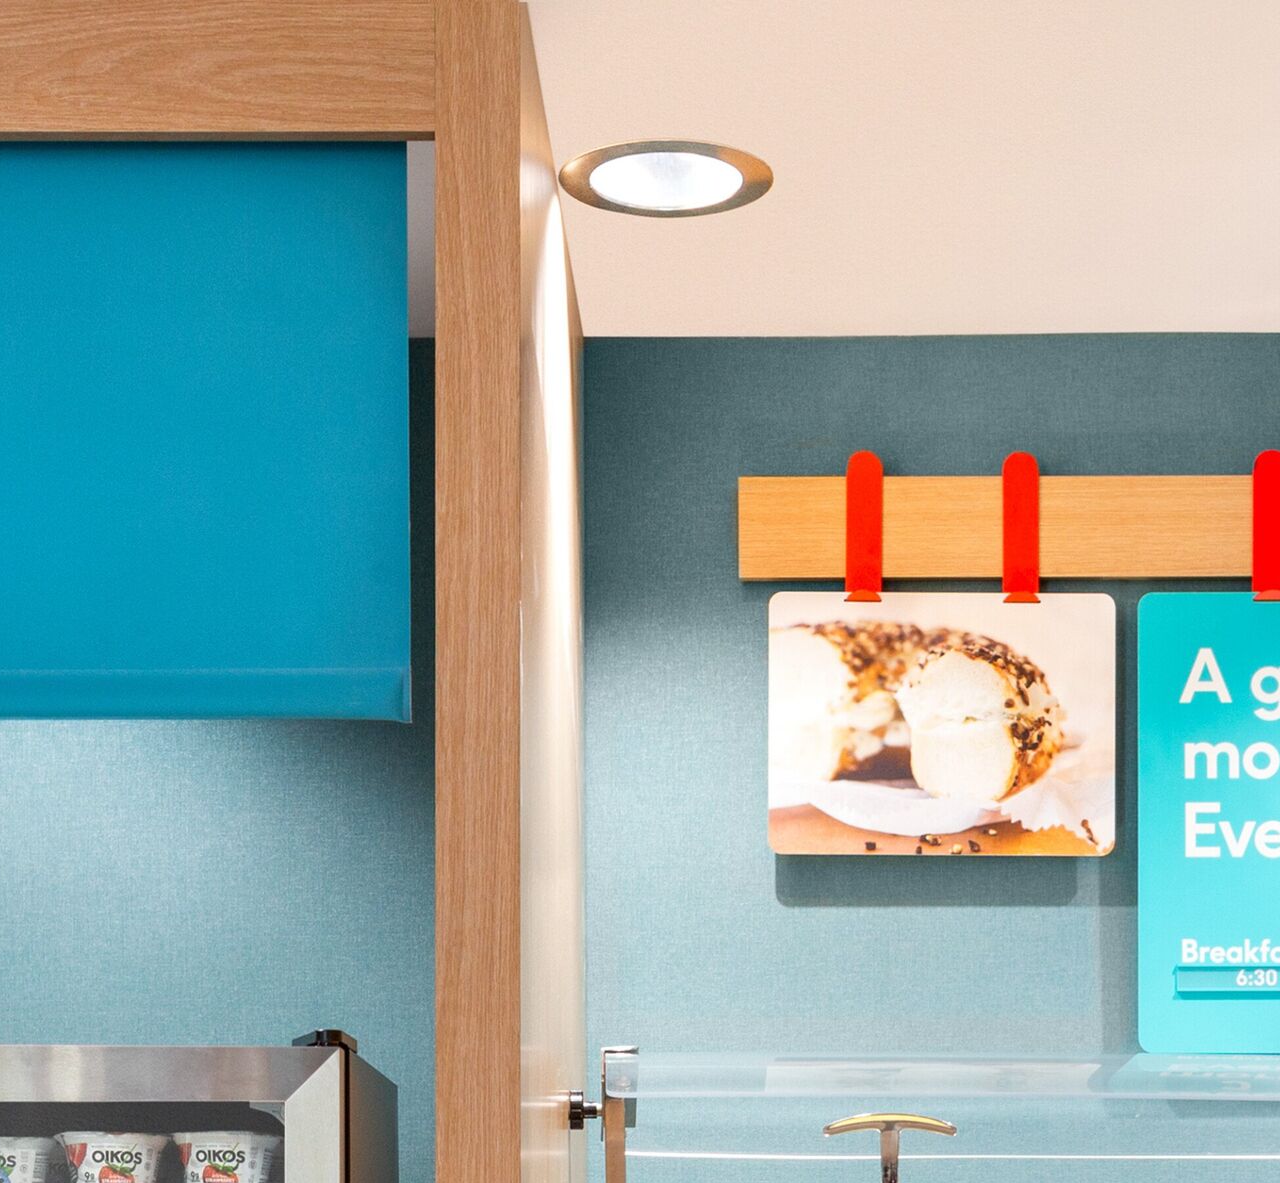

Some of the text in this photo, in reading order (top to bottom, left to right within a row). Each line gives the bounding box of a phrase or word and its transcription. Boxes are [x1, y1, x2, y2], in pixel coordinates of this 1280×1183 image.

[1179, 647, 1233, 704] A
[1235, 969, 1278, 987] 6:30
[92, 1150, 142, 1165] OIKOS
[196, 1150, 246, 1164] OIKOS
